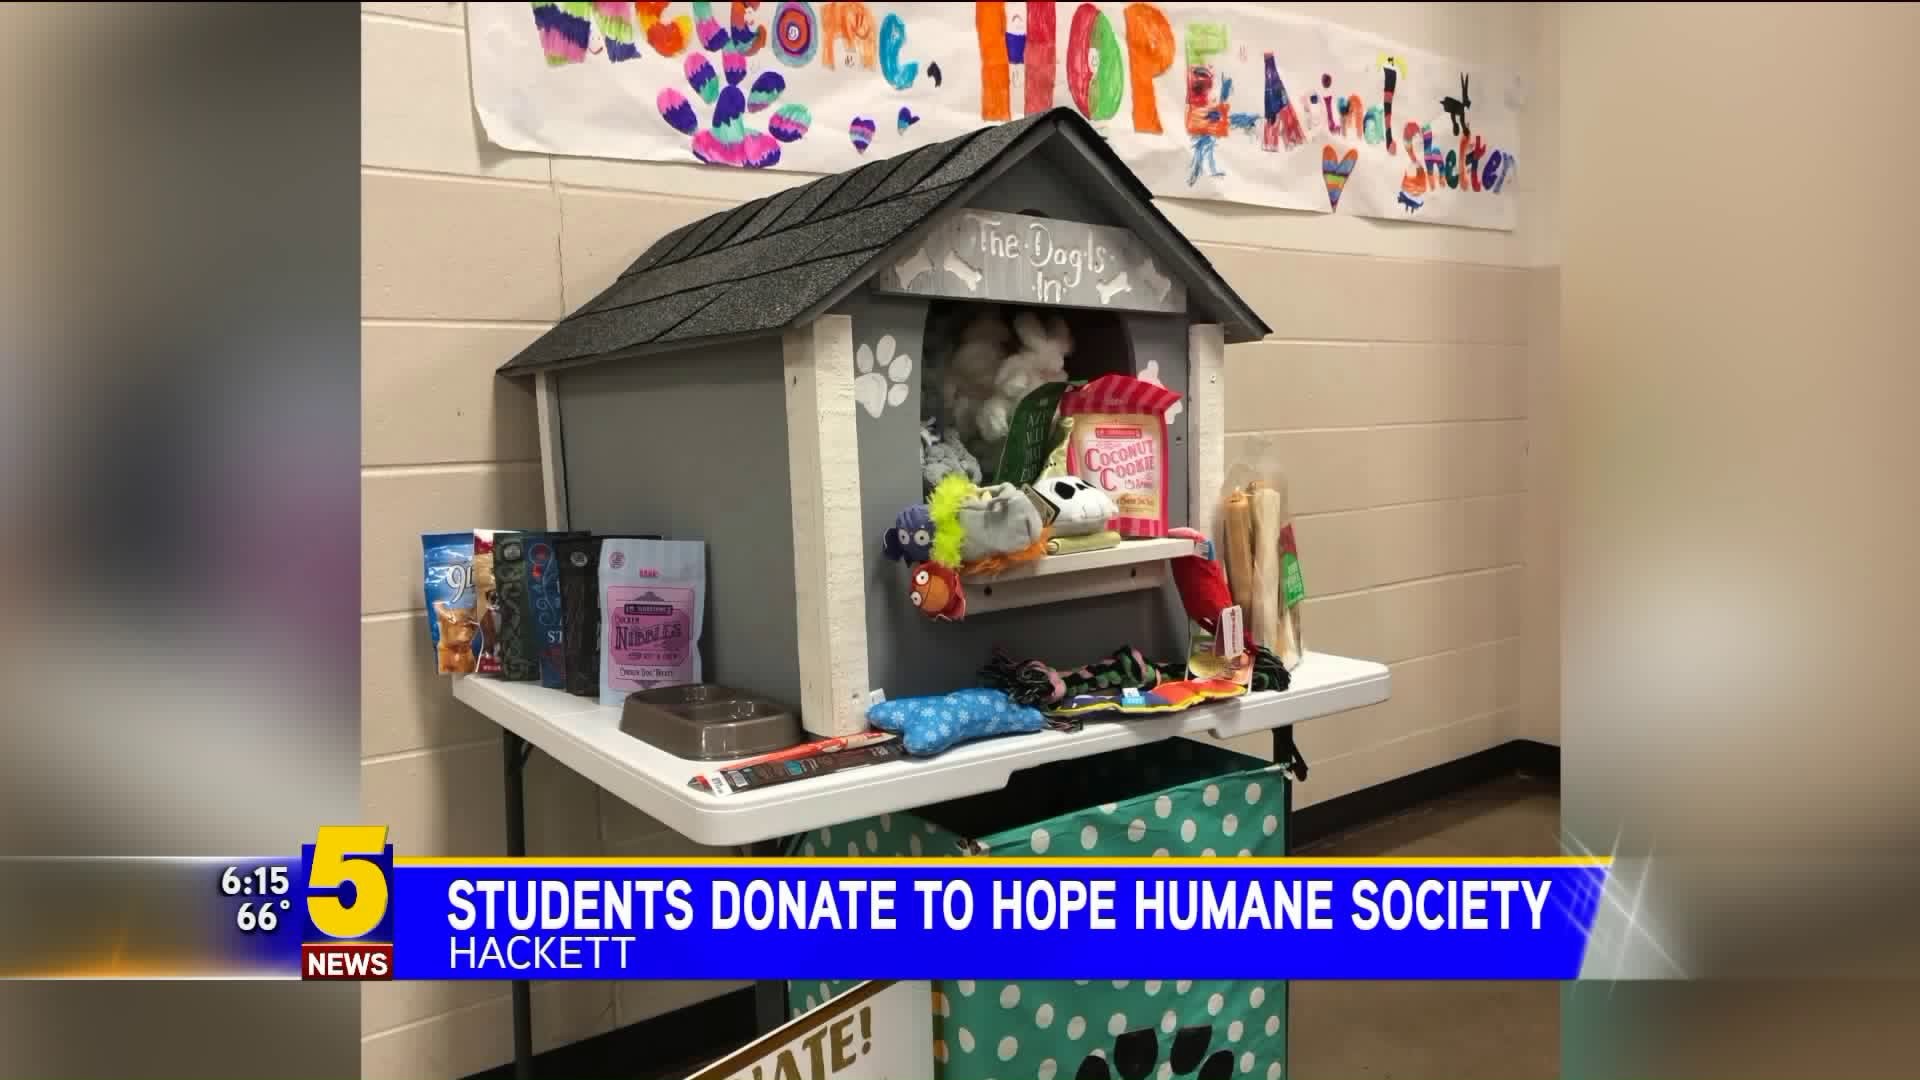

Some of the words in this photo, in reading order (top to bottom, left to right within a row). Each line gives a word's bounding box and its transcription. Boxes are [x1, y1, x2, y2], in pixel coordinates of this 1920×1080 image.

[1401, 121, 1516, 195] Shelter
[964, 213, 1020, 258] The
[1035, 270, 1062, 304] In
[752, 1006, 871, 1080] ATE!
